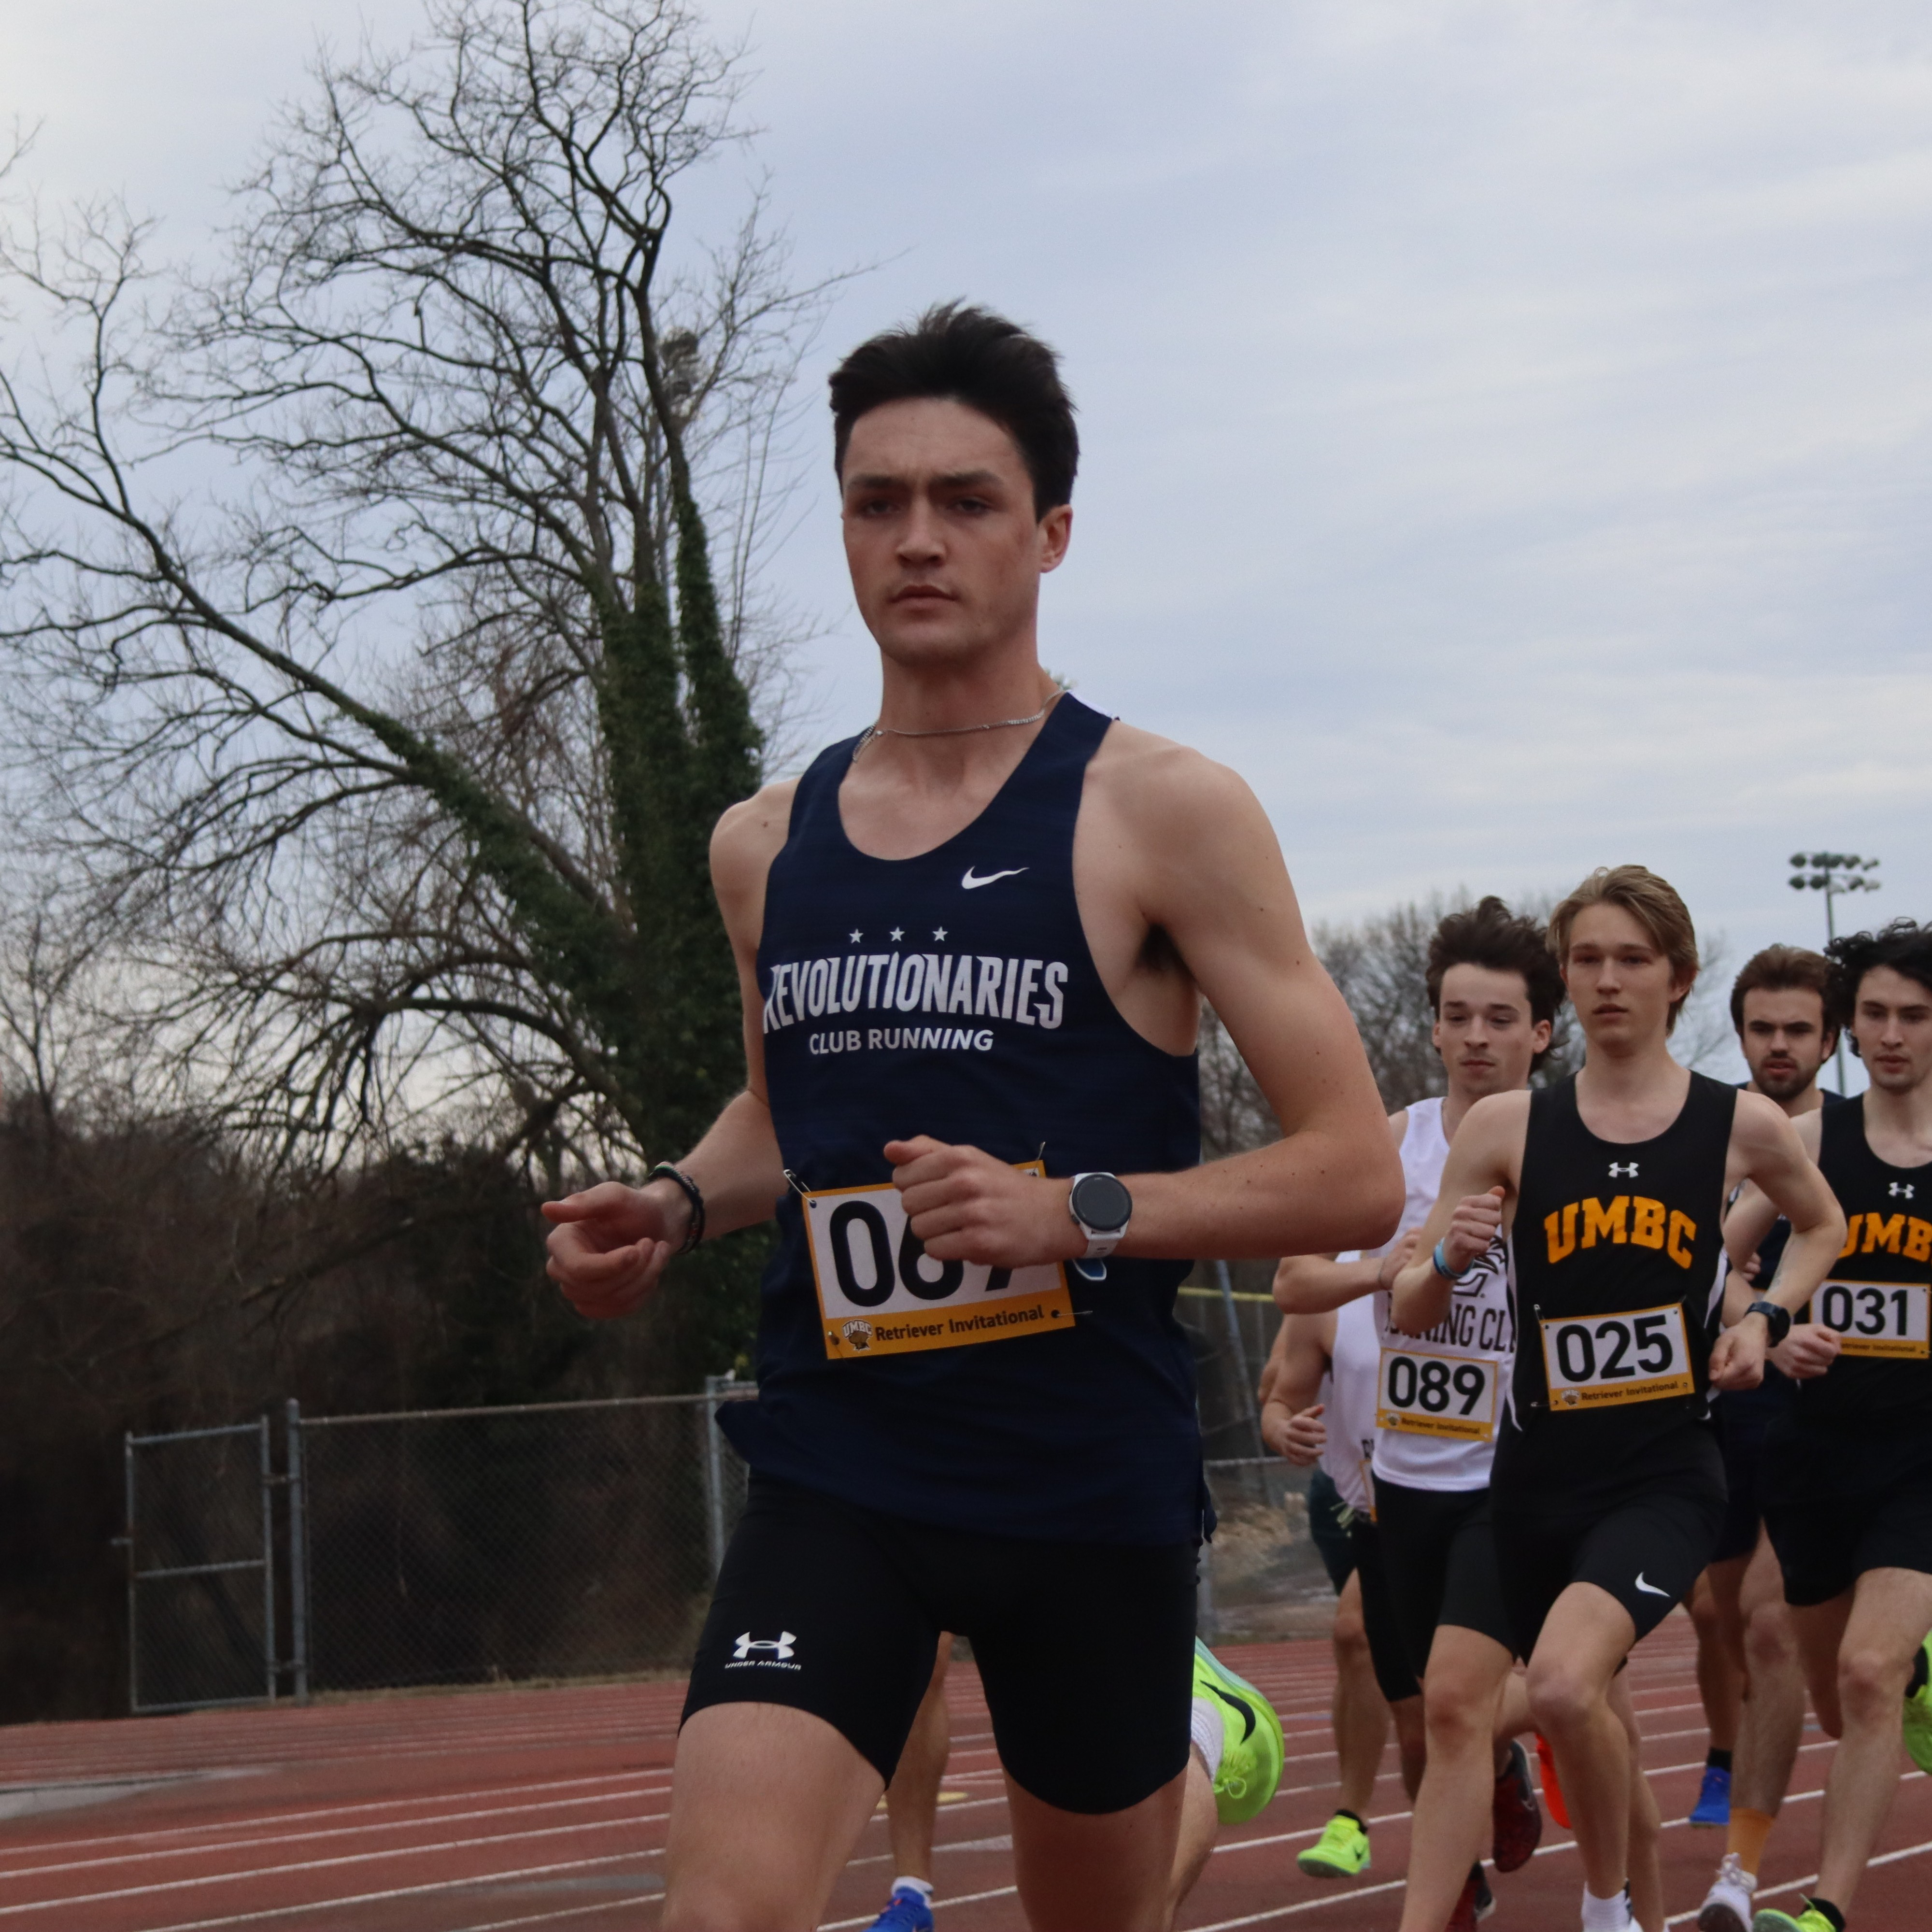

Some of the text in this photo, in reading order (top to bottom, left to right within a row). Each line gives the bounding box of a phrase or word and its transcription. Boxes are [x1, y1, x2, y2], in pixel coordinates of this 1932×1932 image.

[810, 1028, 994, 1054] CLUB RUNNING
[1544, 1195, 1697, 1270] UMBC
[1839, 1212, 1932, 1263] UMB
[842, 1319, 873, 1337] UMBC
[875, 1305, 1044, 1341] Retriever Invitational
[1822, 1285, 1908, 1336] 031
[1556, 1314, 1673, 1382] 025
[1388, 1356, 1485, 1415] 089
[1581, 1390, 1623, 1400] Retriever
[1626, 1381, 1678, 1395] Invitational
[724, 1660, 802, 1671] UNDER ARMOUR
